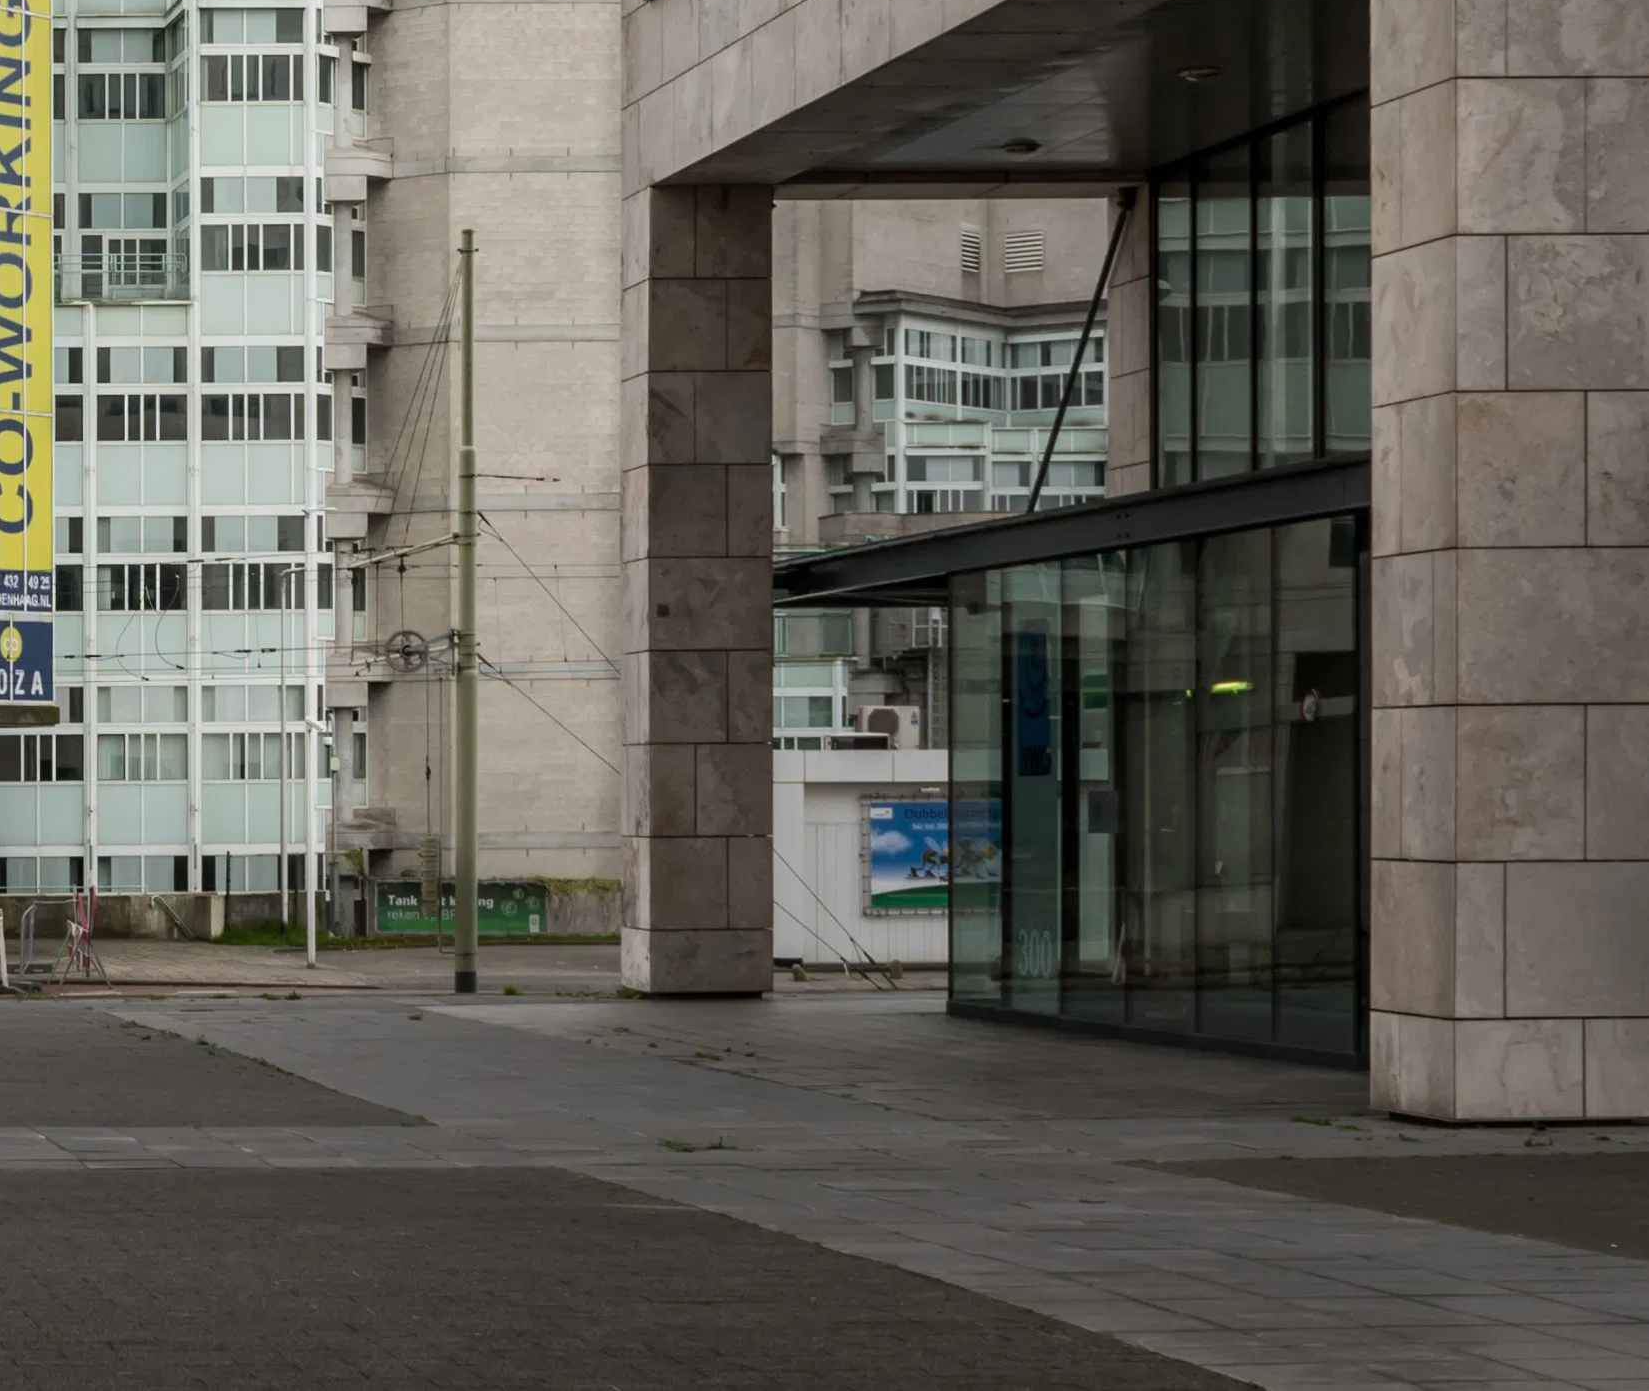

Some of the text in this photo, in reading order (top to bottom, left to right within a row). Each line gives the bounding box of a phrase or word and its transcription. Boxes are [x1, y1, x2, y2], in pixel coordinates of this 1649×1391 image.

[3, 574, 19, 588] 432
[28, 575, 39, 590] 49
[904, 808, 947, 820] Dubbel
[387, 894, 419, 907] Tank
[387, 910, 420, 921] reken
[1017, 928, 1053, 979] 300
